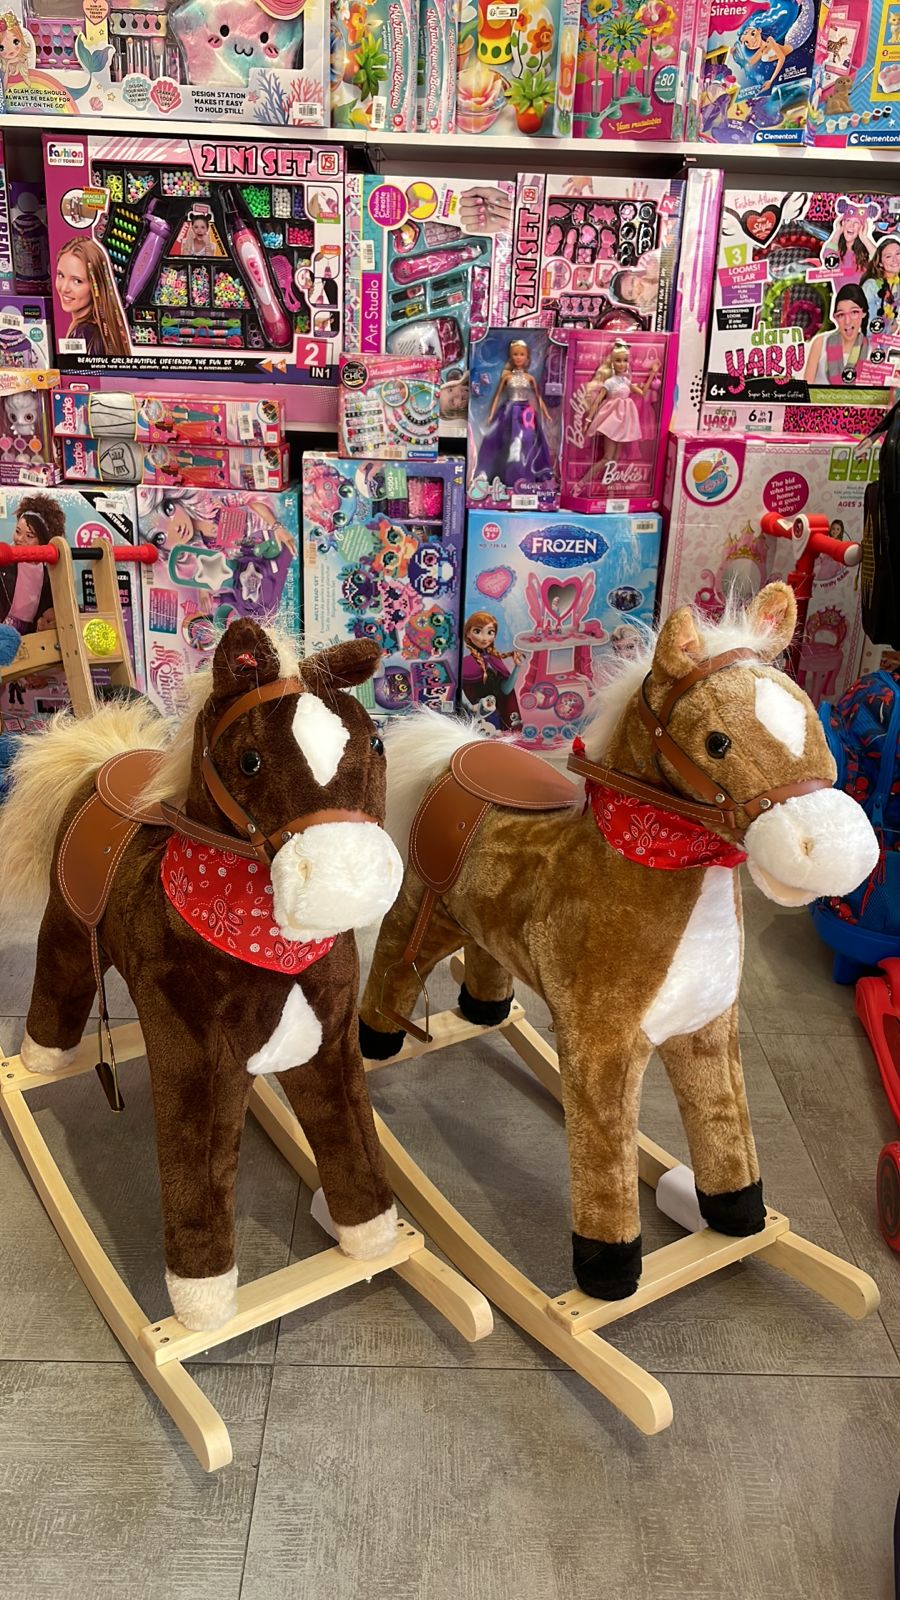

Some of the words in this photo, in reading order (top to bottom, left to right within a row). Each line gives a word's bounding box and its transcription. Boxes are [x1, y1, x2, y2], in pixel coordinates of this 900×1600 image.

[710, 5, 747, 16] Sirènes
[660, 73, 675, 86] 80
[390, 72, 404, 109] Bougies
[860, 134, 900, 143] Clementoni
[49, 144, 83, 158] Fashion
[202, 144, 258, 175] 2IN1
[260, 146, 312, 176] SET
[663, 199, 674, 209] 2
[516, 208, 540, 255] SET
[753, 222, 772, 232] Style
[732, 248, 741, 264] 3
[728, 264, 760, 275] LOOMS!
[732, 273, 755, 282] TELAR
[513, 258, 538, 308] 2IN1
[364, 280, 379, 319] Studio
[364, 324, 378, 346] Art
[751, 324, 802, 346] darn
[304, 342, 319, 366] 2
[312, 367, 330, 378] IN1
[725, 343, 805, 394] YARN
[710, 385, 726, 396] 6+
[62, 396, 76, 433] Barbie
[566, 384, 587, 448] Barbie
[715, 406, 736, 416] darn
[749, 410, 757, 422] 6
[768, 411, 773, 422] 1
[703, 415, 737, 428] YARN
[72, 441, 86, 476] Barbie
[602, 460, 643, 484] Barbie
[777, 492, 794, 500] home
[784, 495, 800, 505] good
[531, 537, 597, 554] FROZEN
[150, 641, 171, 675] Star
